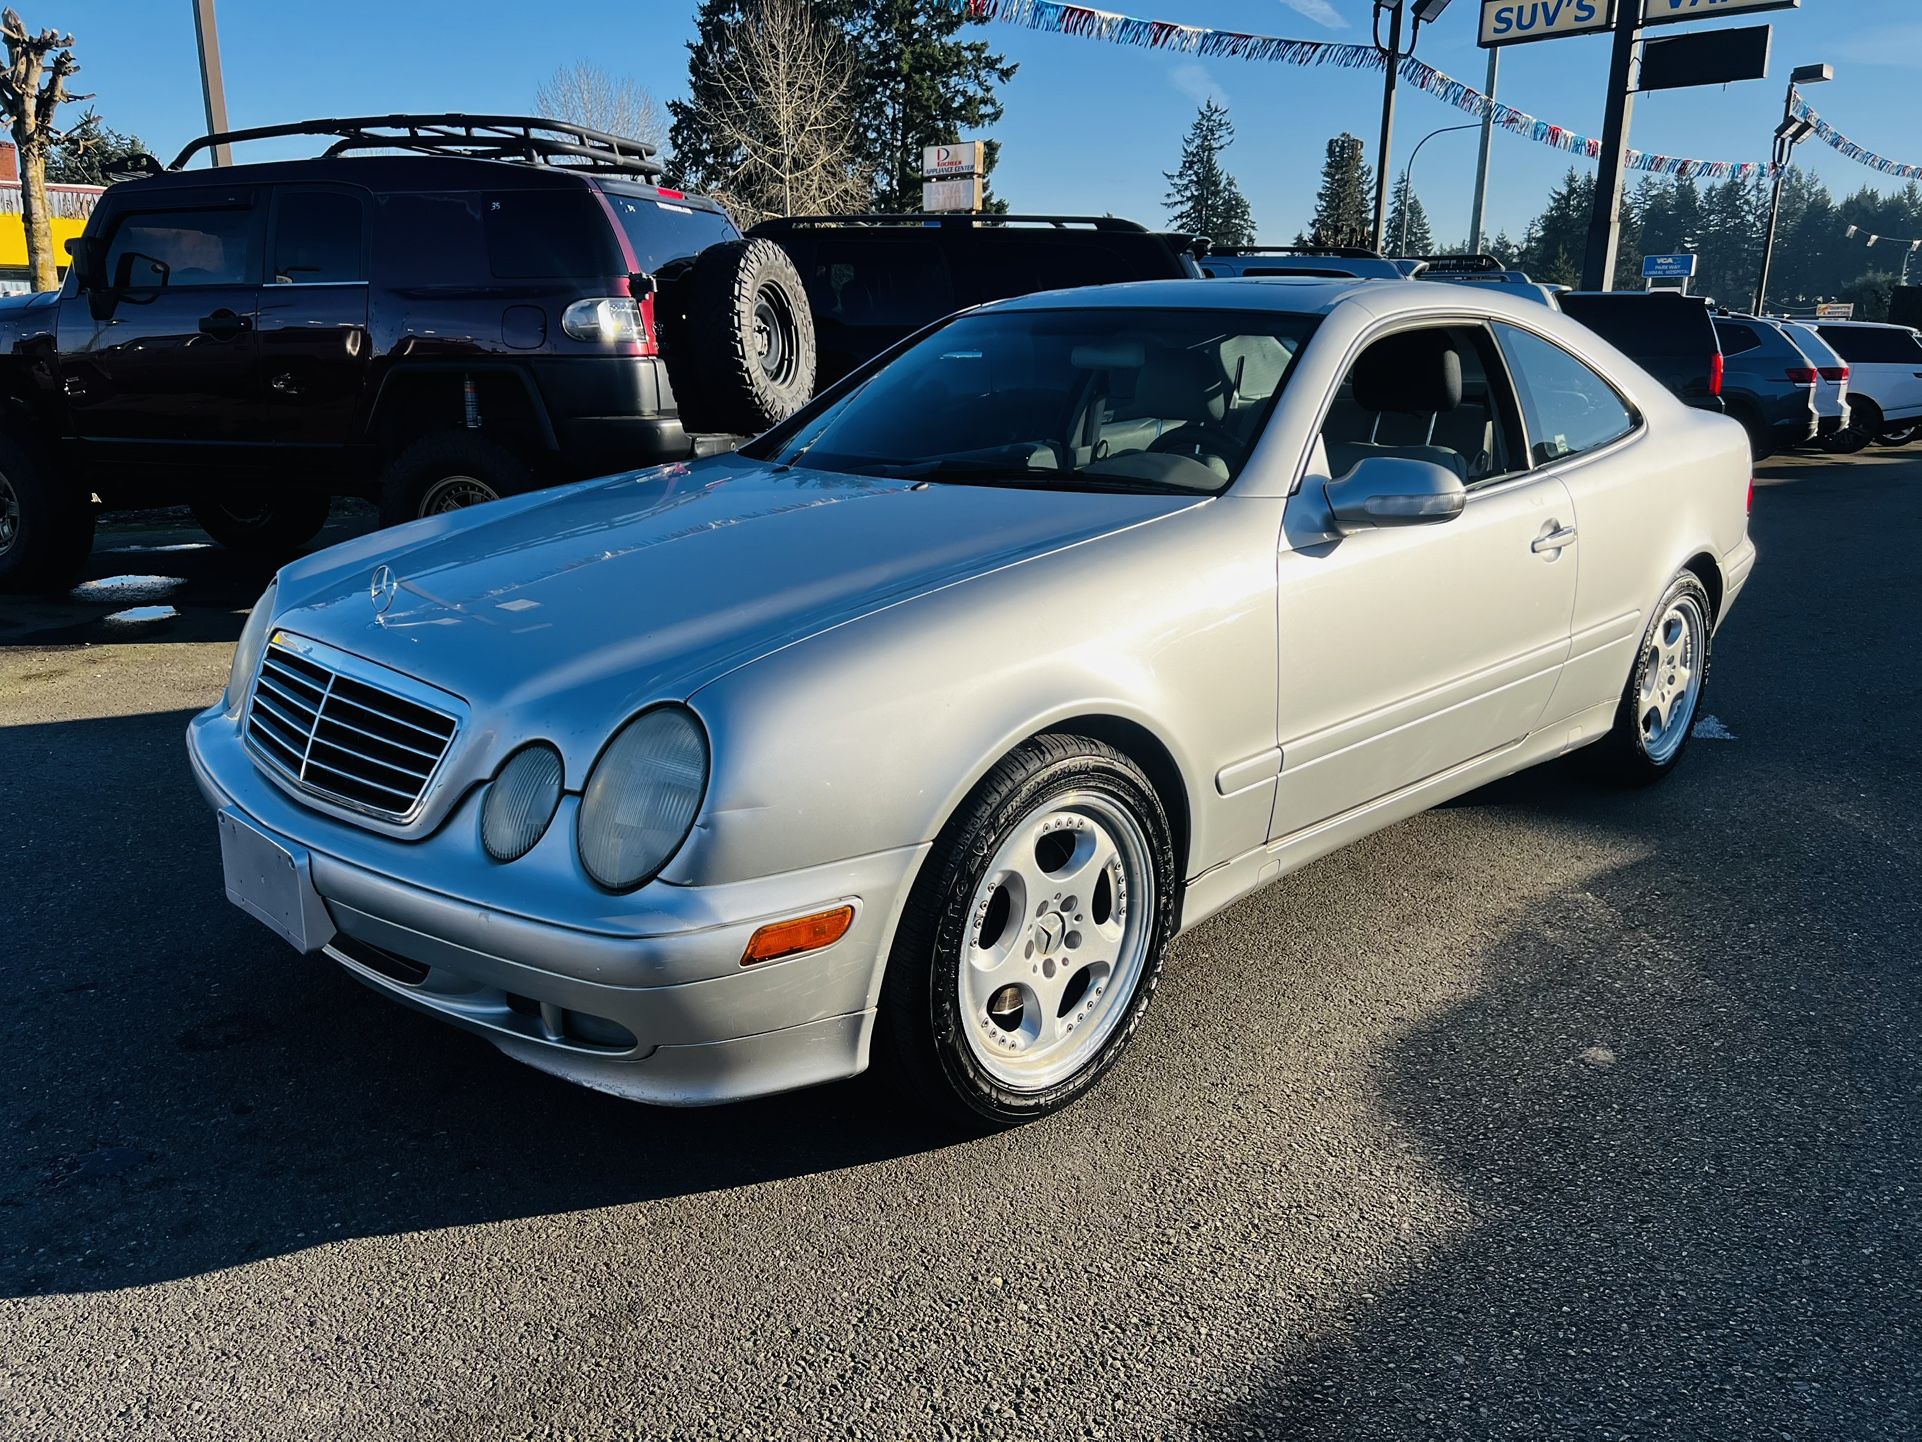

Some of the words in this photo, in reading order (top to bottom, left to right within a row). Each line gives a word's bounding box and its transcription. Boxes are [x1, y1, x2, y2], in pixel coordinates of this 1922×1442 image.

[1493, 0, 1596, 33] SUV'S
[926, 166, 953, 175] APPLIANCE
[954, 164, 975, 173] CENTER
